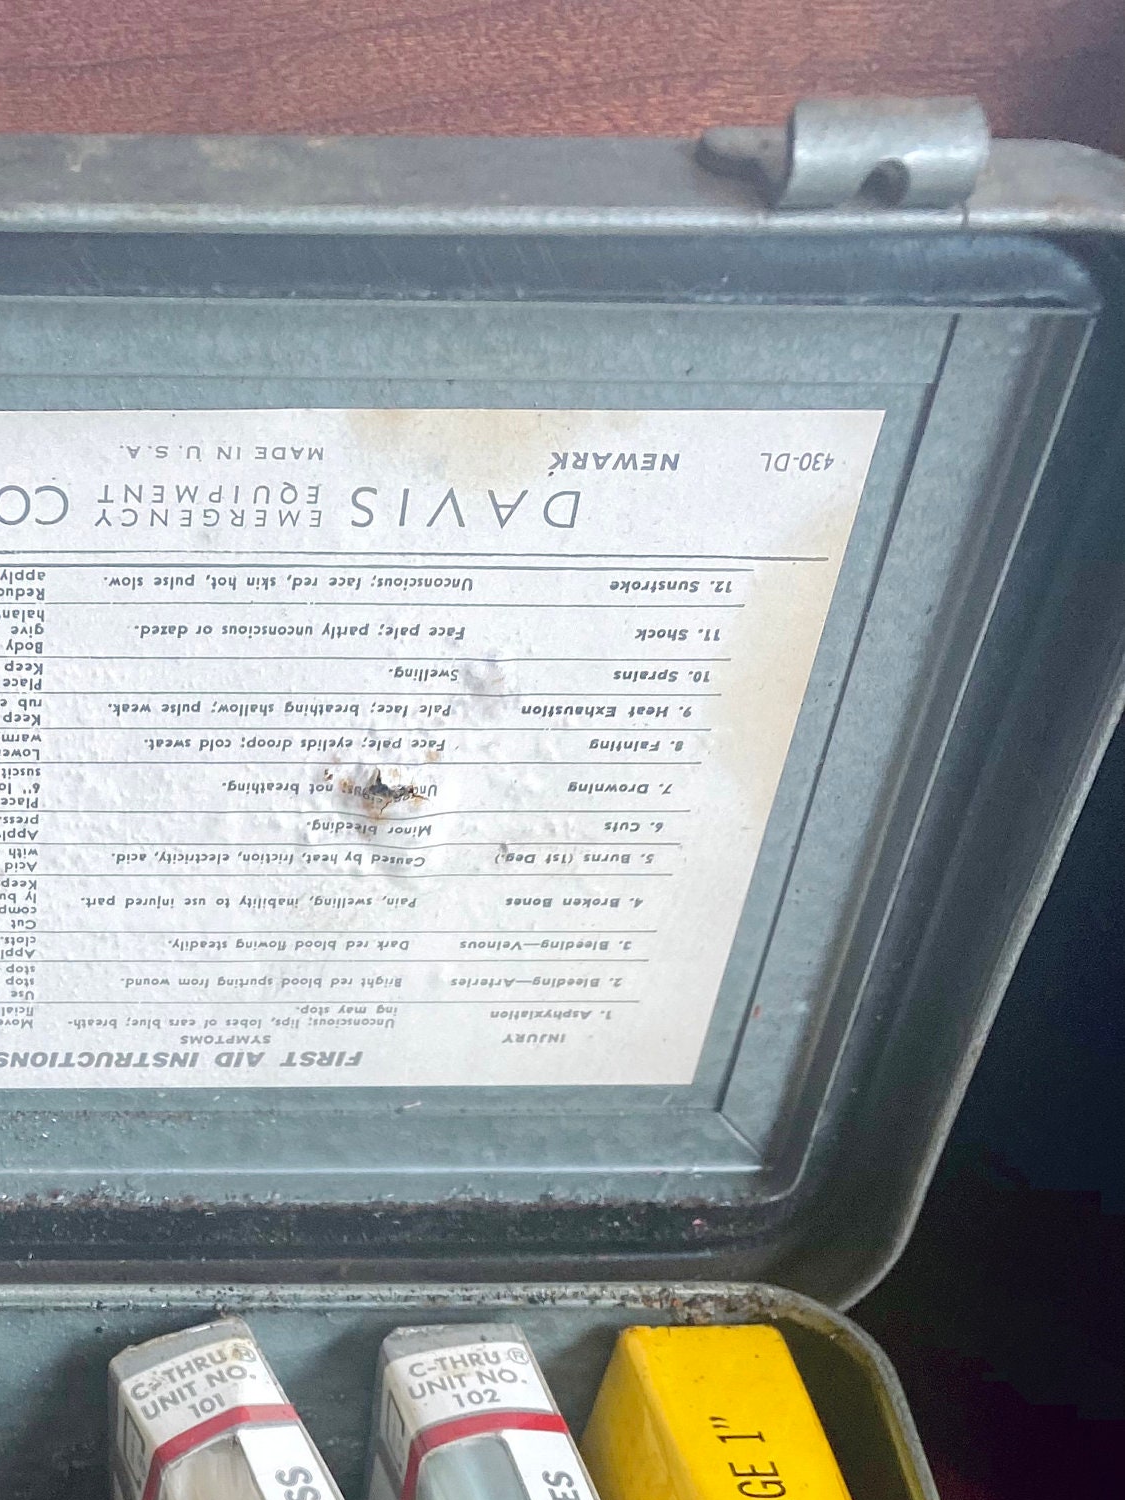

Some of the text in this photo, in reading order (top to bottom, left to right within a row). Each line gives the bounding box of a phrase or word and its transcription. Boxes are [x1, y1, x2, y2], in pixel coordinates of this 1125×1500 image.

[216, 440, 242, 461] IN
[254, 445, 324, 462] MADE
[547, 451, 681, 474] NEWARK
[760, 452, 835, 473] 430-DL
[96, 481, 322, 505] EQUIPMENT
[94, 507, 323, 528] EMERGENCY
[350, 486, 582, 530] DAVIS
[609, 580, 732, 594] 12. Sunstroke
[634, 628, 721, 642] 11. Shock
[388, 665, 460, 683] Swelling.
[612, 668, 710, 683] 10. Sprains
[520, 705, 692, 719] 9. Heat Exhaustion
[179, 1034, 272, 1046] SYMPTOMS
[501, 1032, 567, 1044] INJURY
[213, 1048, 266, 1069] AID
[278, 1050, 364, 1068] FIRST
[141, 1365, 257, 1420] UNIT NO.
[408, 1368, 528, 1400] UNIT NO.
[188, 1393, 226, 1418] 101
[452, 1388, 501, 1408] 102
